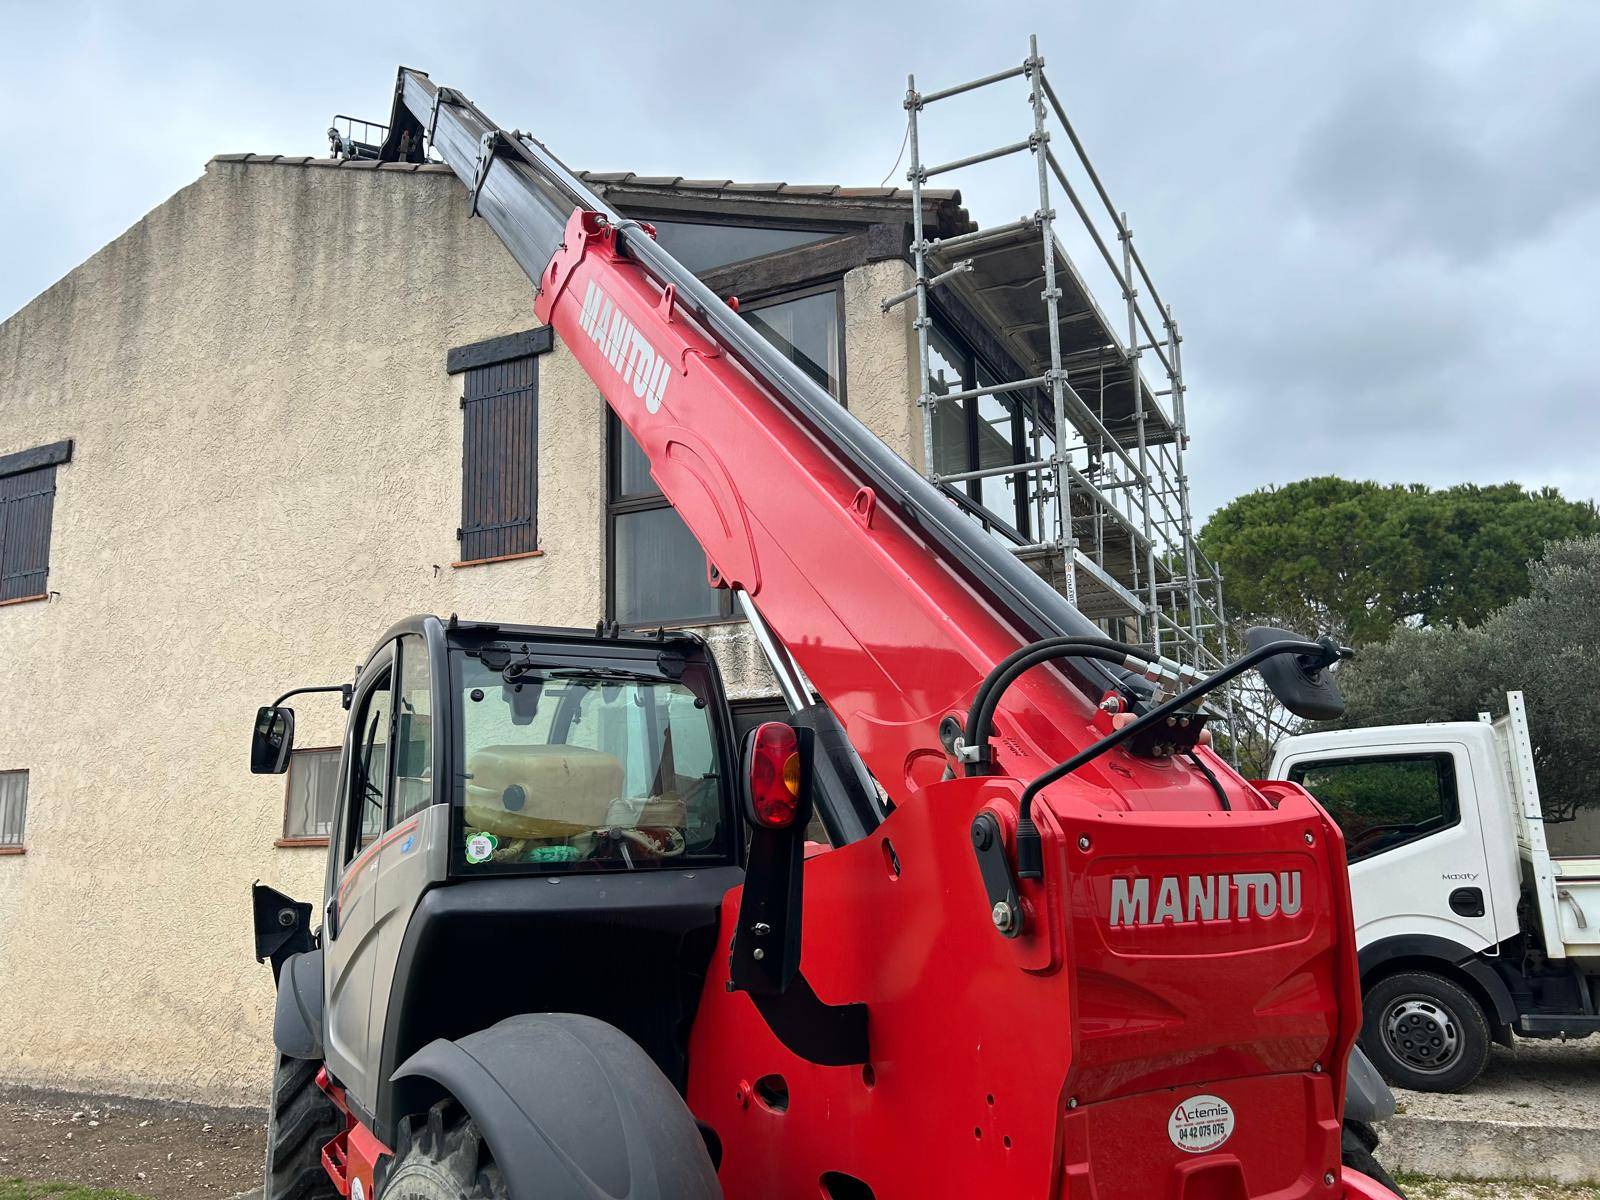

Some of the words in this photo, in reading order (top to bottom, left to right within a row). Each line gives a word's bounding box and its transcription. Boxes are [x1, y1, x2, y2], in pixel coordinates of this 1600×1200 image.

[579, 280, 671, 414] MANITOU
[1441, 873, 1479, 881] Maxity
[1109, 871, 1302, 927] MANITOU
[1175, 1104, 1228, 1122] Actemis
[1179, 1128, 1188, 1140] 04
[1189, 1127, 1198, 1139] 42
[1199, 1124, 1211, 1137] 075
[1212, 1123, 1225, 1135] 075
